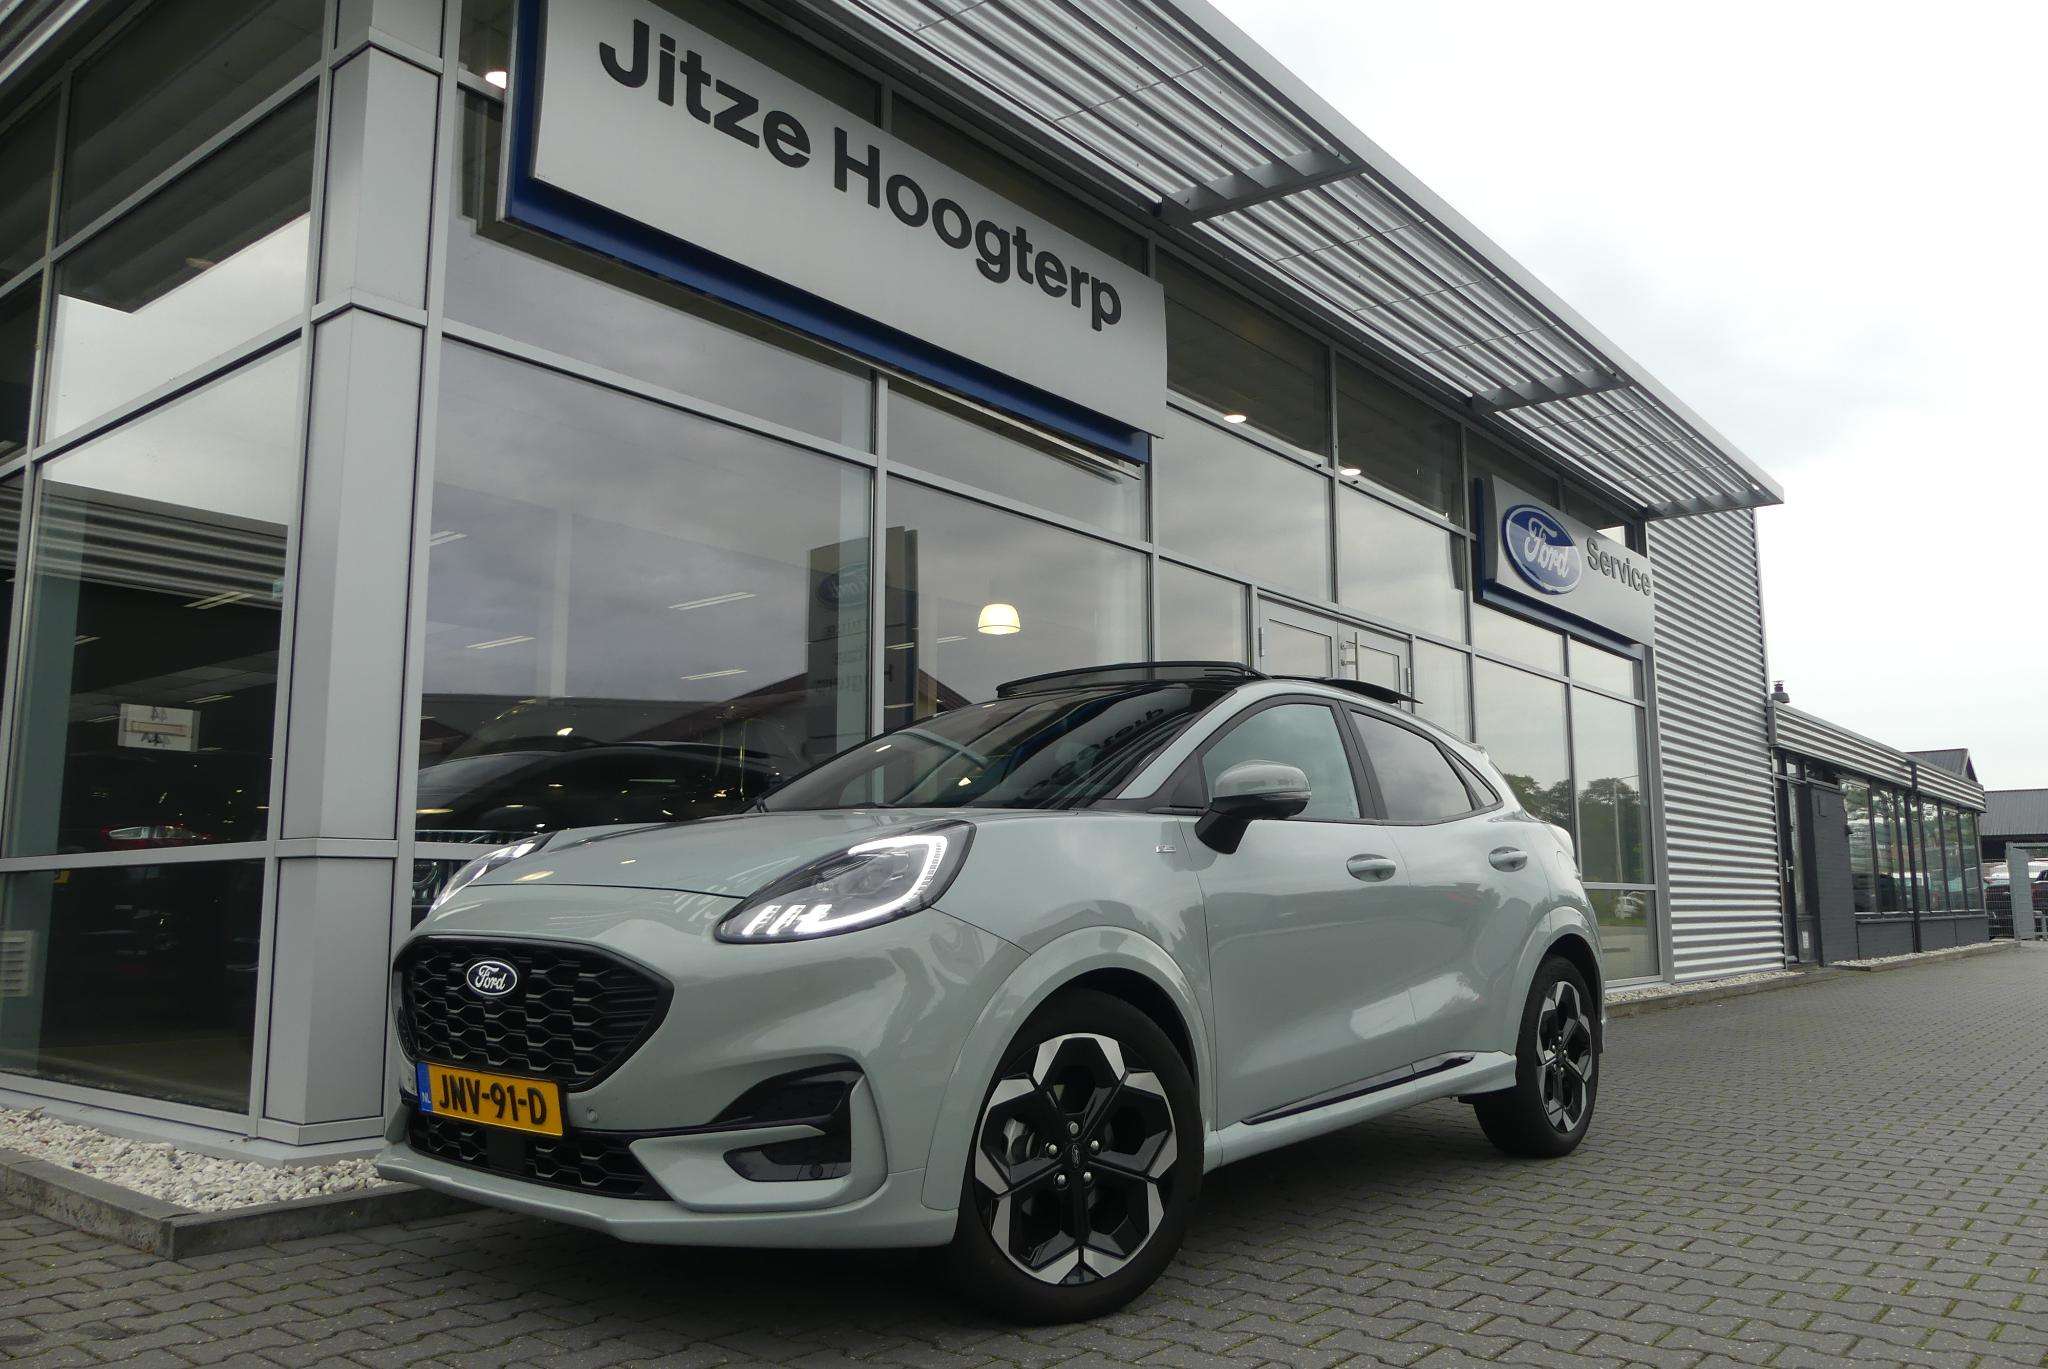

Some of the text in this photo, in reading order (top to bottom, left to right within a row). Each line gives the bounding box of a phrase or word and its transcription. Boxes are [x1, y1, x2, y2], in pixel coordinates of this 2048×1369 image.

[599, 18, 1122, 332] Jitze Hoogterp
[1524, 516, 1652, 597] Ford Service
[474, 964, 506, 991] Ford
[421, 1073, 547, 1126] NL JNV-91-D
